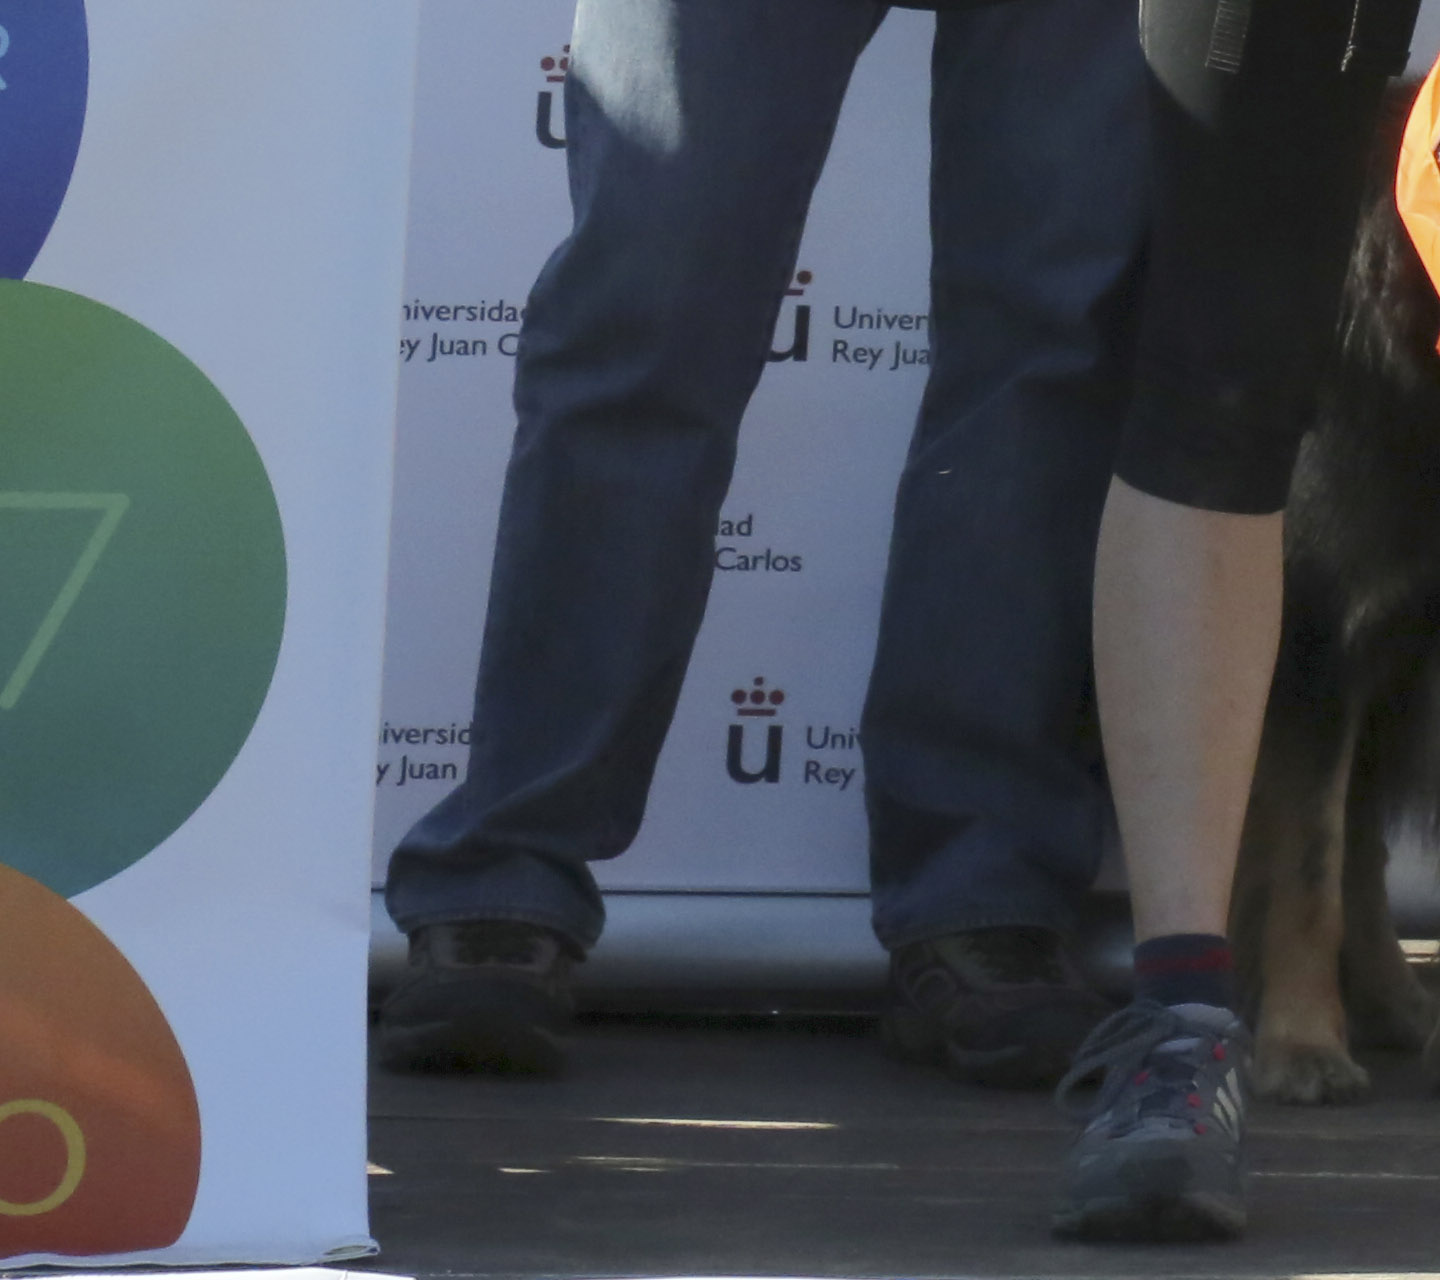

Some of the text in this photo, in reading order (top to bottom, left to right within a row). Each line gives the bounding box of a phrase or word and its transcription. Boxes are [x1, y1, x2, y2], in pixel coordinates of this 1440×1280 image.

[833, 305, 930, 331] Univer
[427, 332, 487, 362] Juan
[832, 339, 881, 371] Rey
[397, 755, 457, 786] Juan
[804, 759, 856, 792] Rey
